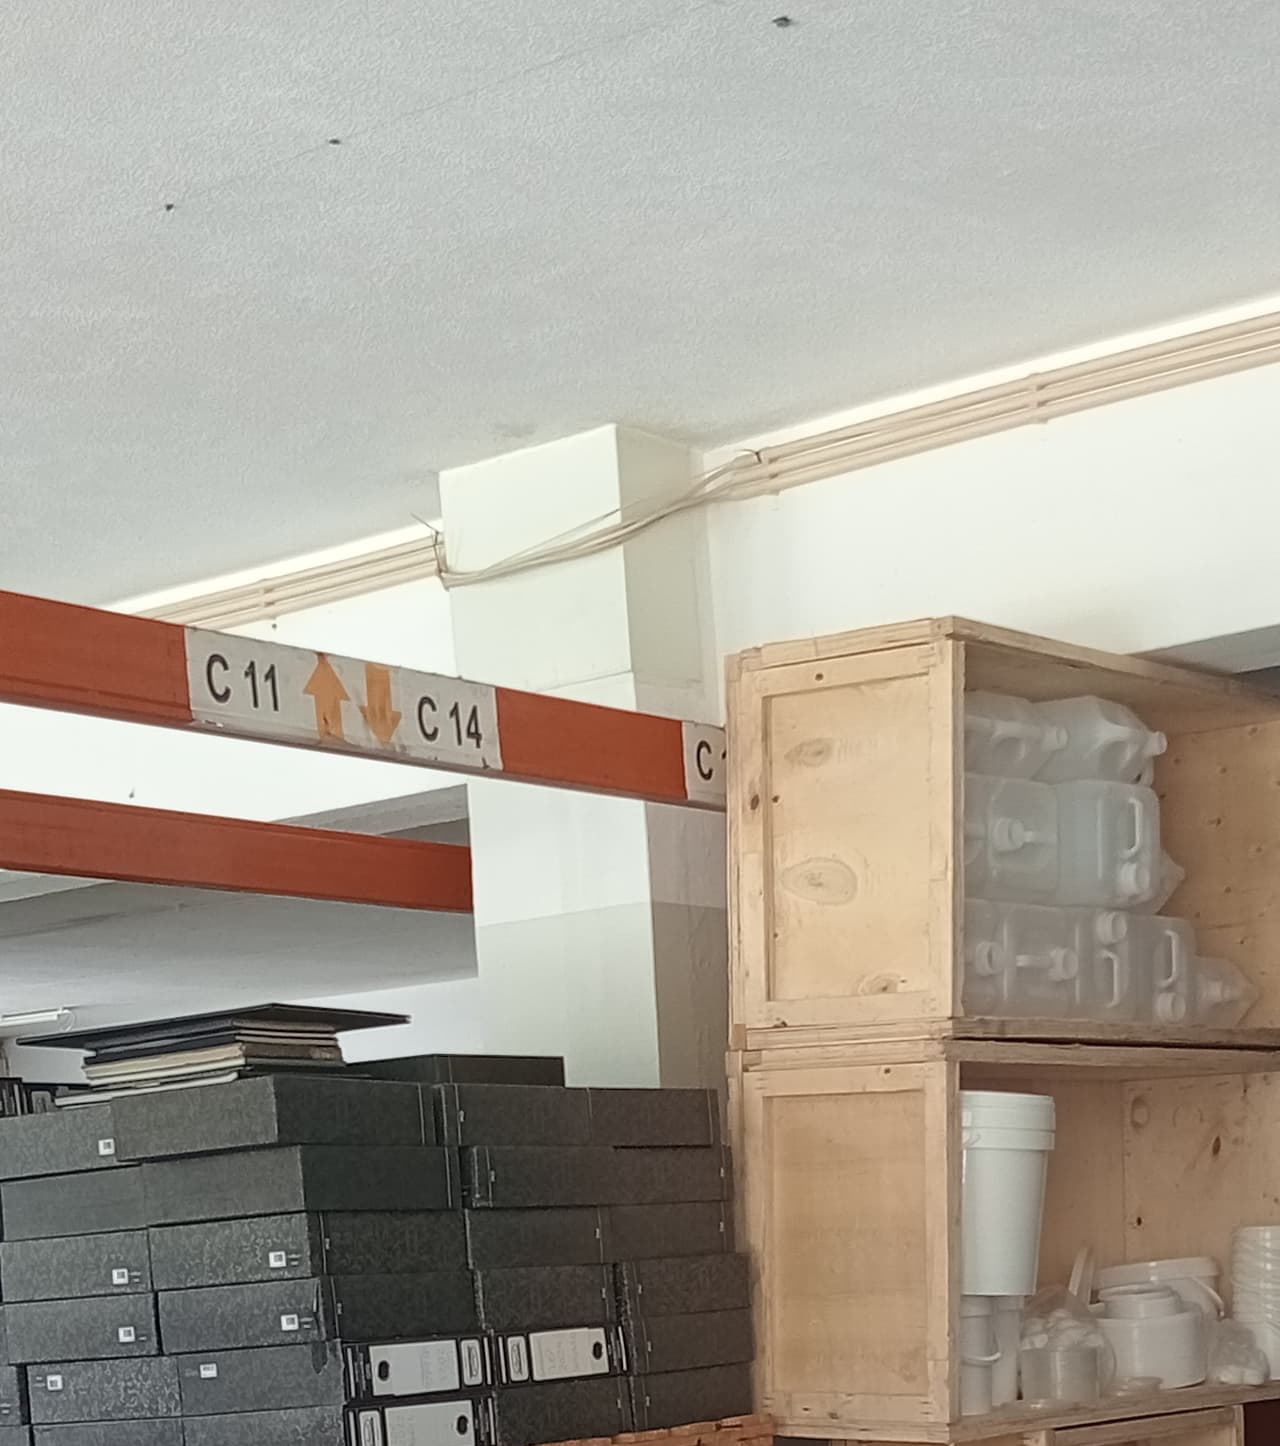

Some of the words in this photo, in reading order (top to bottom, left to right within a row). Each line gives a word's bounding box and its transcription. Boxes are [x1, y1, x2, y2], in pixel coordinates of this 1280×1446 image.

[205, 654, 231, 705] C
[243, 661, 280, 712] 11
[417, 696, 439, 744] C
[448, 702, 483, 749] 14
[696, 740, 714, 780] C
